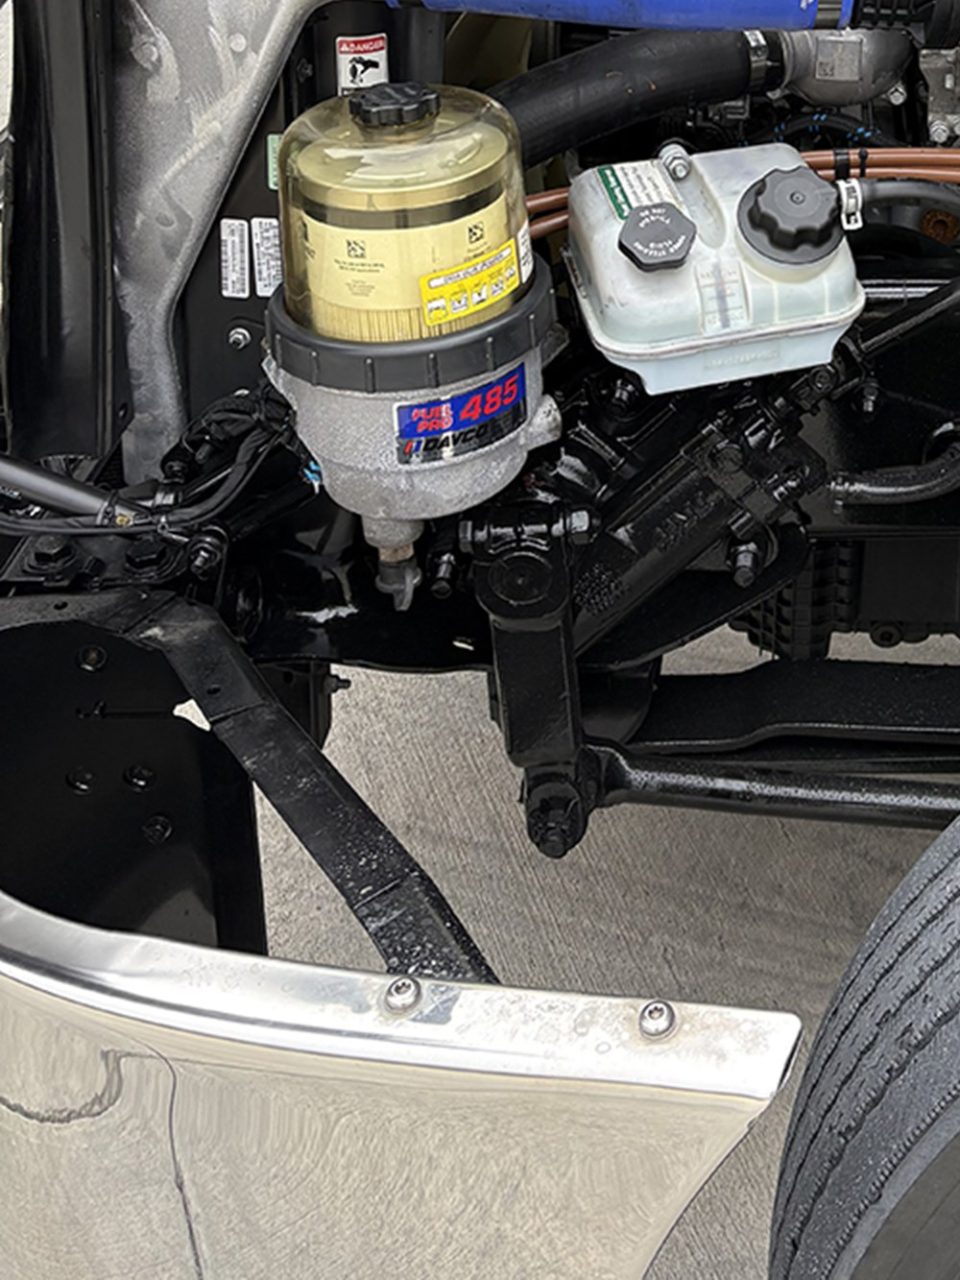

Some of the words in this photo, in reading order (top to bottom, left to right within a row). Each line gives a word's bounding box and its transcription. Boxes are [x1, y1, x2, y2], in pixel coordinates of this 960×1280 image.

[459, 374, 519, 421] 485
[411, 403, 453, 421] FUEL
[416, 416, 454, 433] PRO
[422, 427, 488, 452] DAVCO
